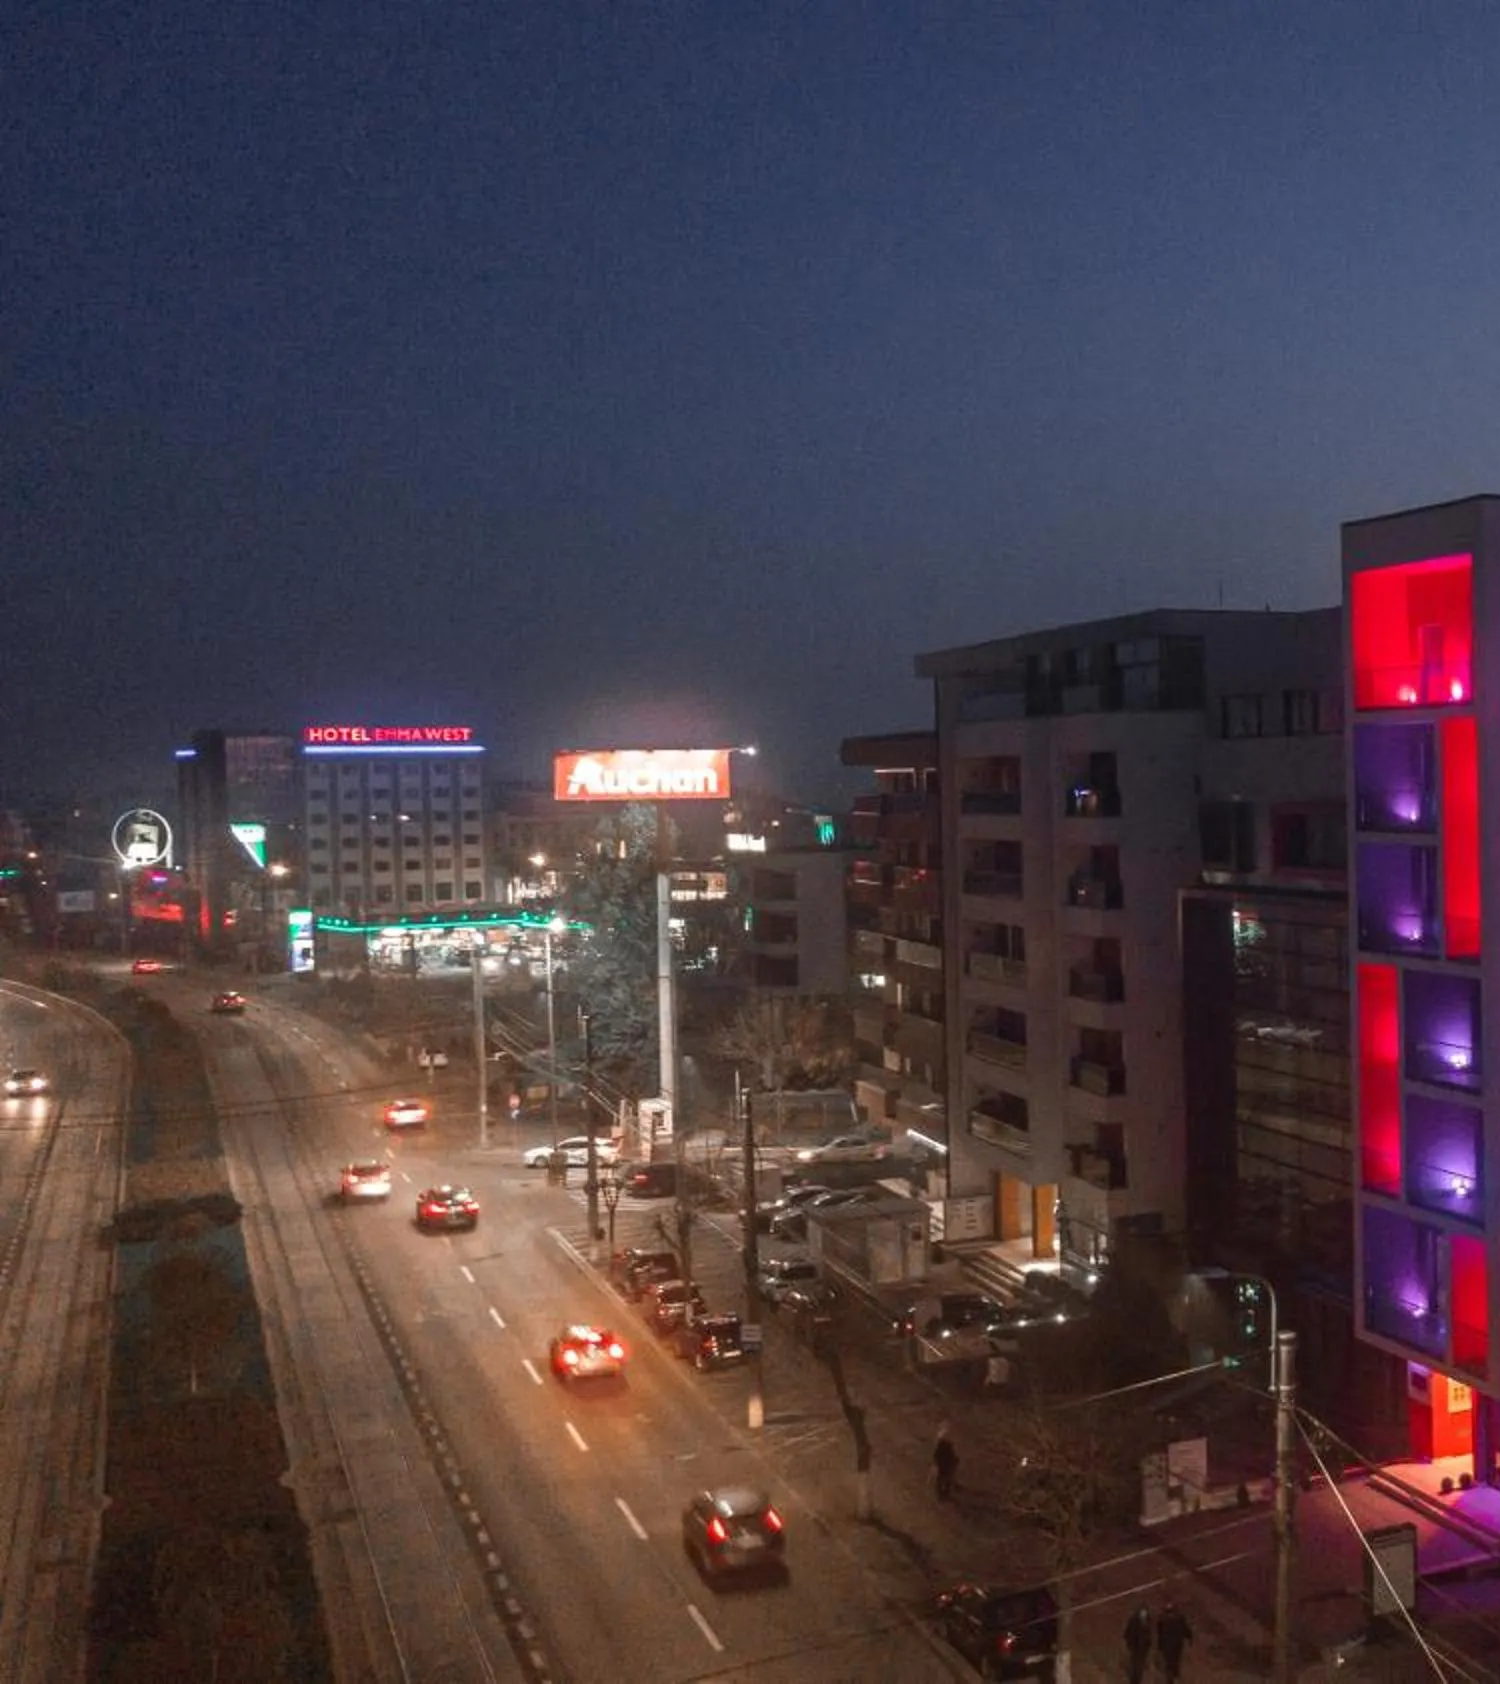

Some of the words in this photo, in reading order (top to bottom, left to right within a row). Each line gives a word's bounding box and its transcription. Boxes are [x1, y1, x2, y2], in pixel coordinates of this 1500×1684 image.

[308, 727, 371, 741] HOTEL
[425, 727, 472, 741] WEST
[567, 757, 718, 795] Auchan
